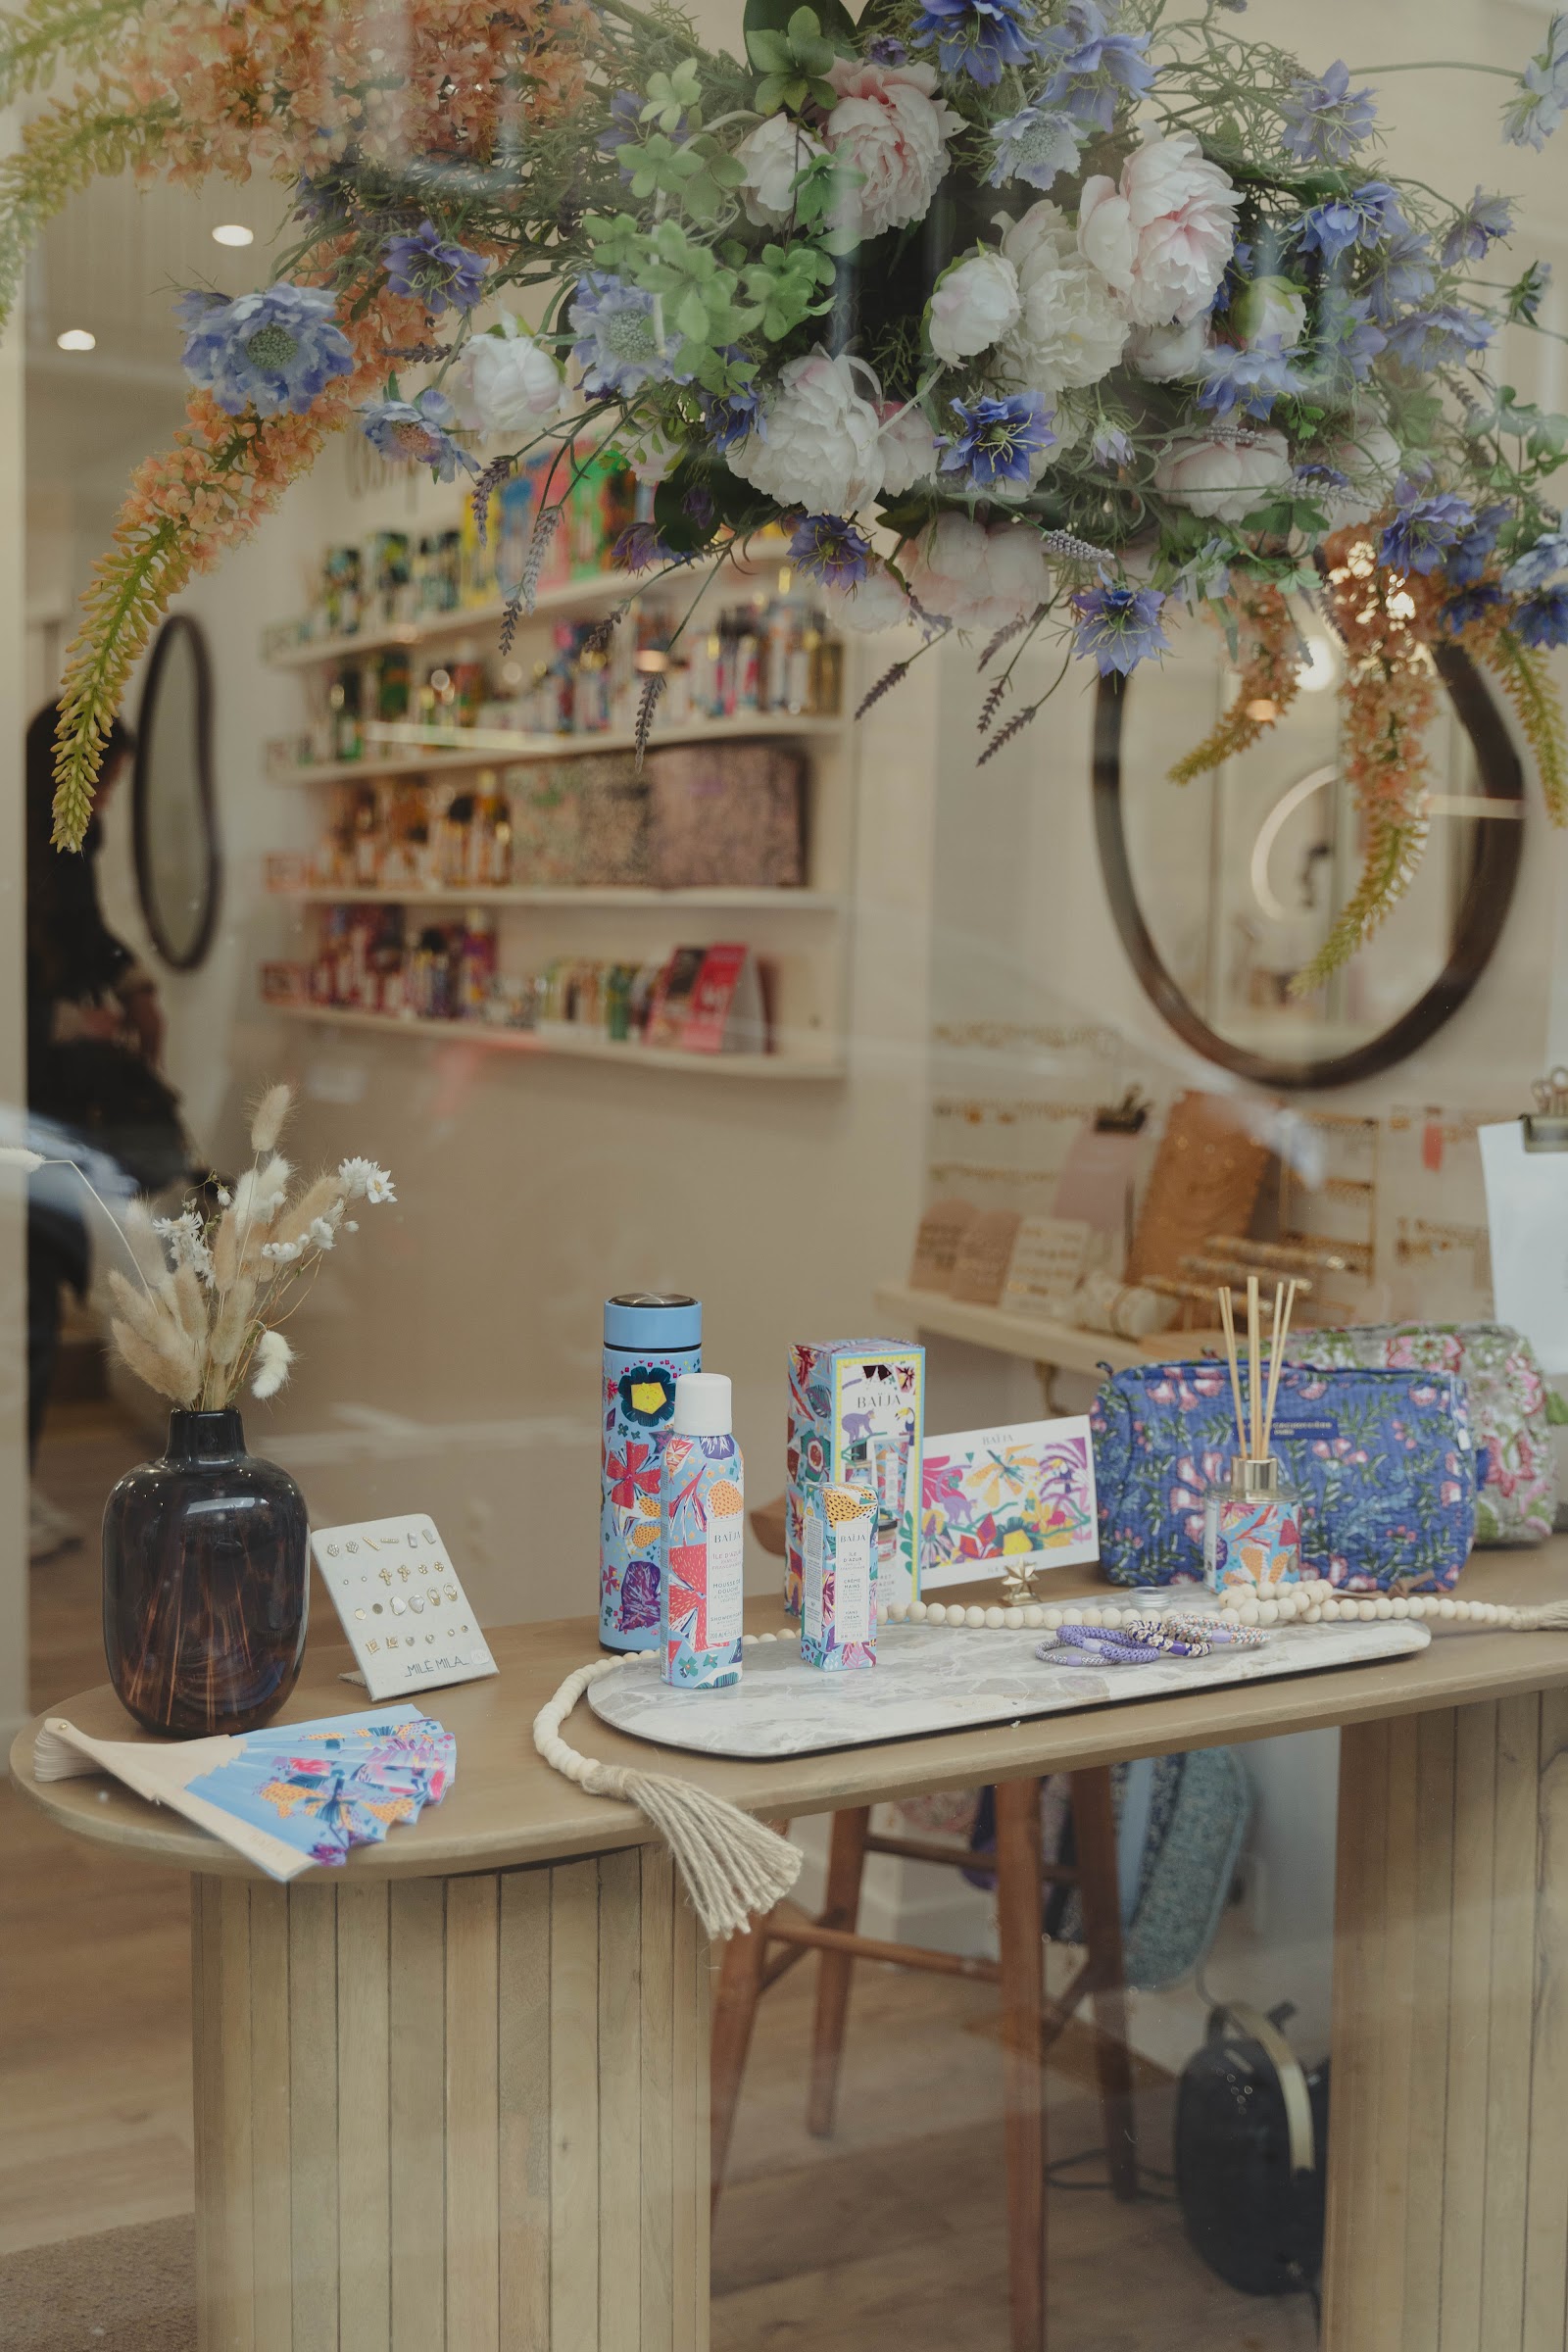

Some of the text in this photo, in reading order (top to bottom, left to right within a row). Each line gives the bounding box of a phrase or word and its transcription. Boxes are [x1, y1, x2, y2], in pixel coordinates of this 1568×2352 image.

[858, 1393, 901, 1408] BAÏJA
[714, 1531, 741, 1543] BAÏJA
[840, 1534, 865, 1543] BAÏJA
[712, 1580, 735, 1589] MOUSSE
[435, 1656, 469, 1670] MILA
